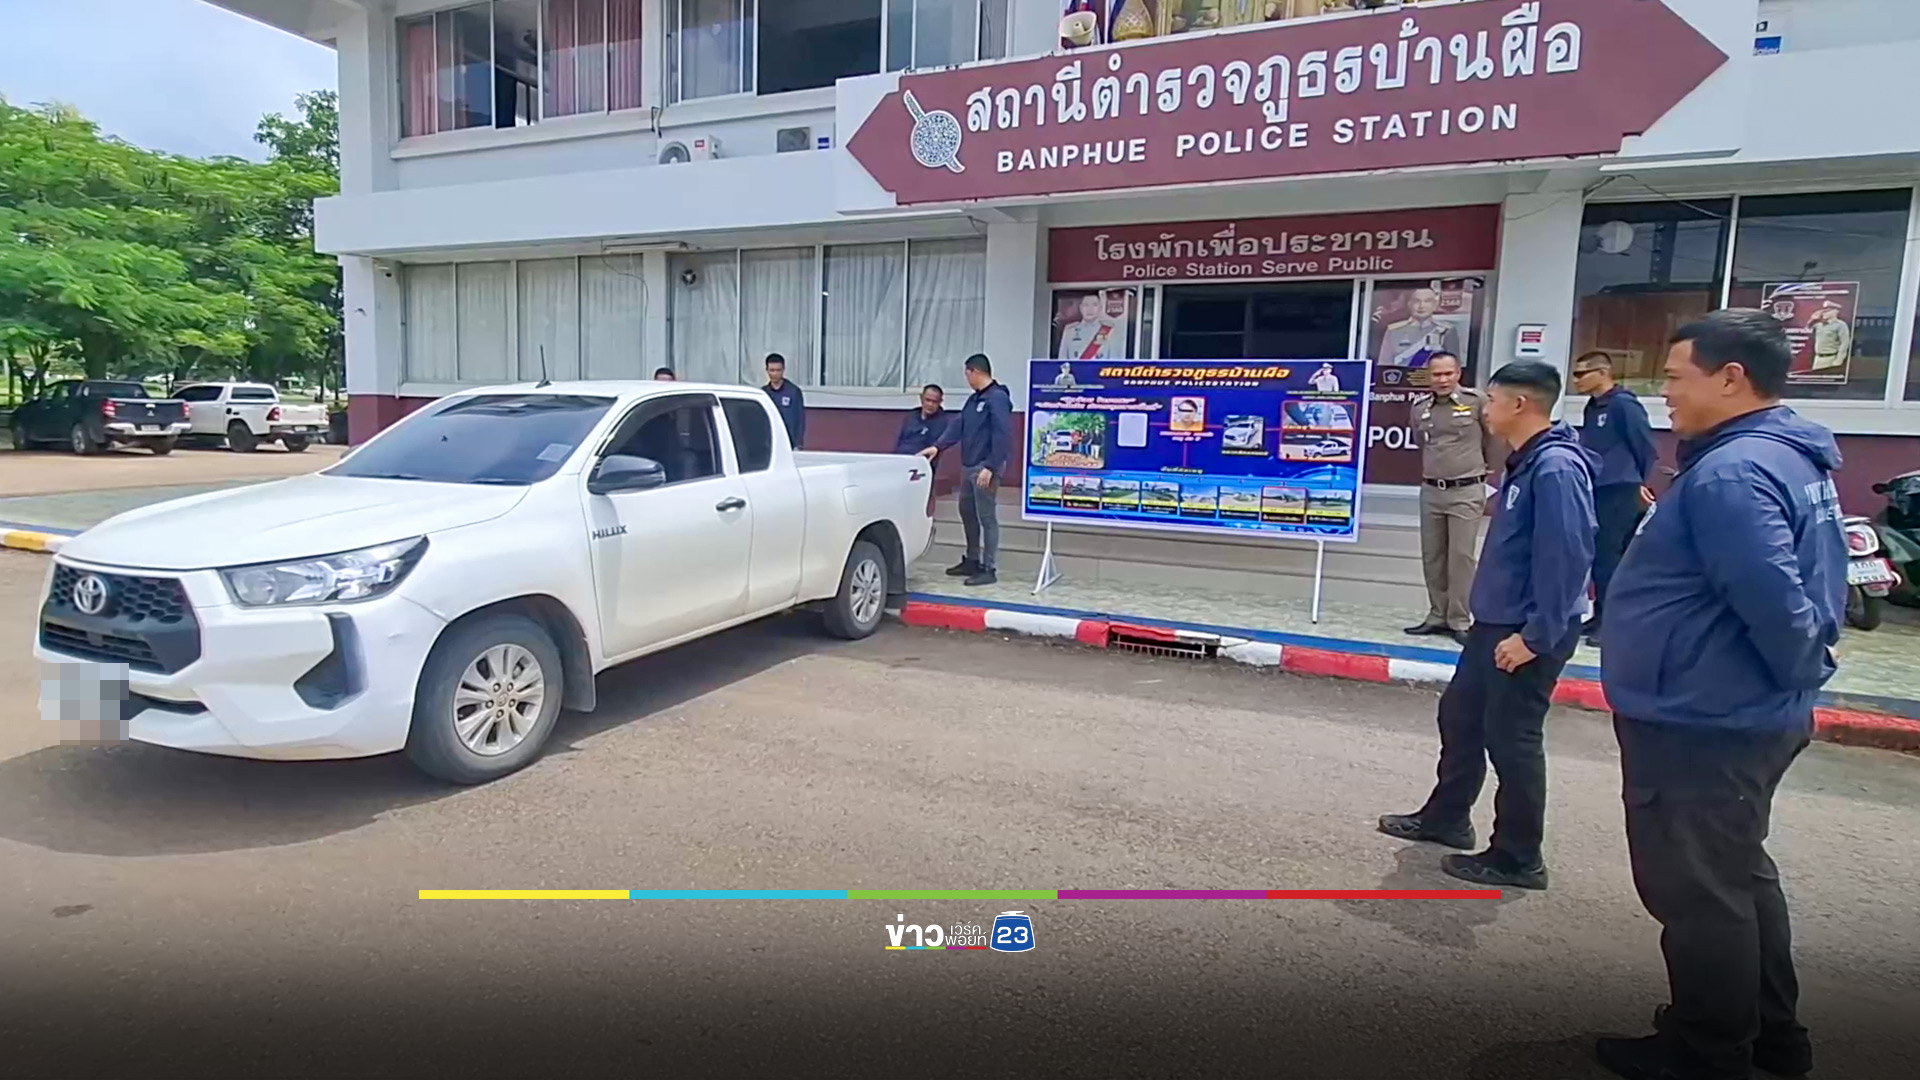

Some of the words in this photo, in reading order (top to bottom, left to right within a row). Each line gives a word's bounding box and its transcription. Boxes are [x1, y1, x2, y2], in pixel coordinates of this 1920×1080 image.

[966, 1, 1582, 132] สถานีตำรวจภูธรบ้านผือ
[997, 138, 1147, 173] BANPHUE
[1176, 123, 1309, 157] POLICE
[1333, 103, 1517, 144] STATION
[1094, 223, 1434, 261] โรงพักเพื่อประชาชน
[1122, 263, 1177, 278] Police
[1186, 261, 1252, 277] Station
[1261, 258, 1318, 274] Serve
[1328, 256, 1393, 272] Public
[1369, 392, 1405, 402] Banphue
[592, 525, 627, 540] HILUX
